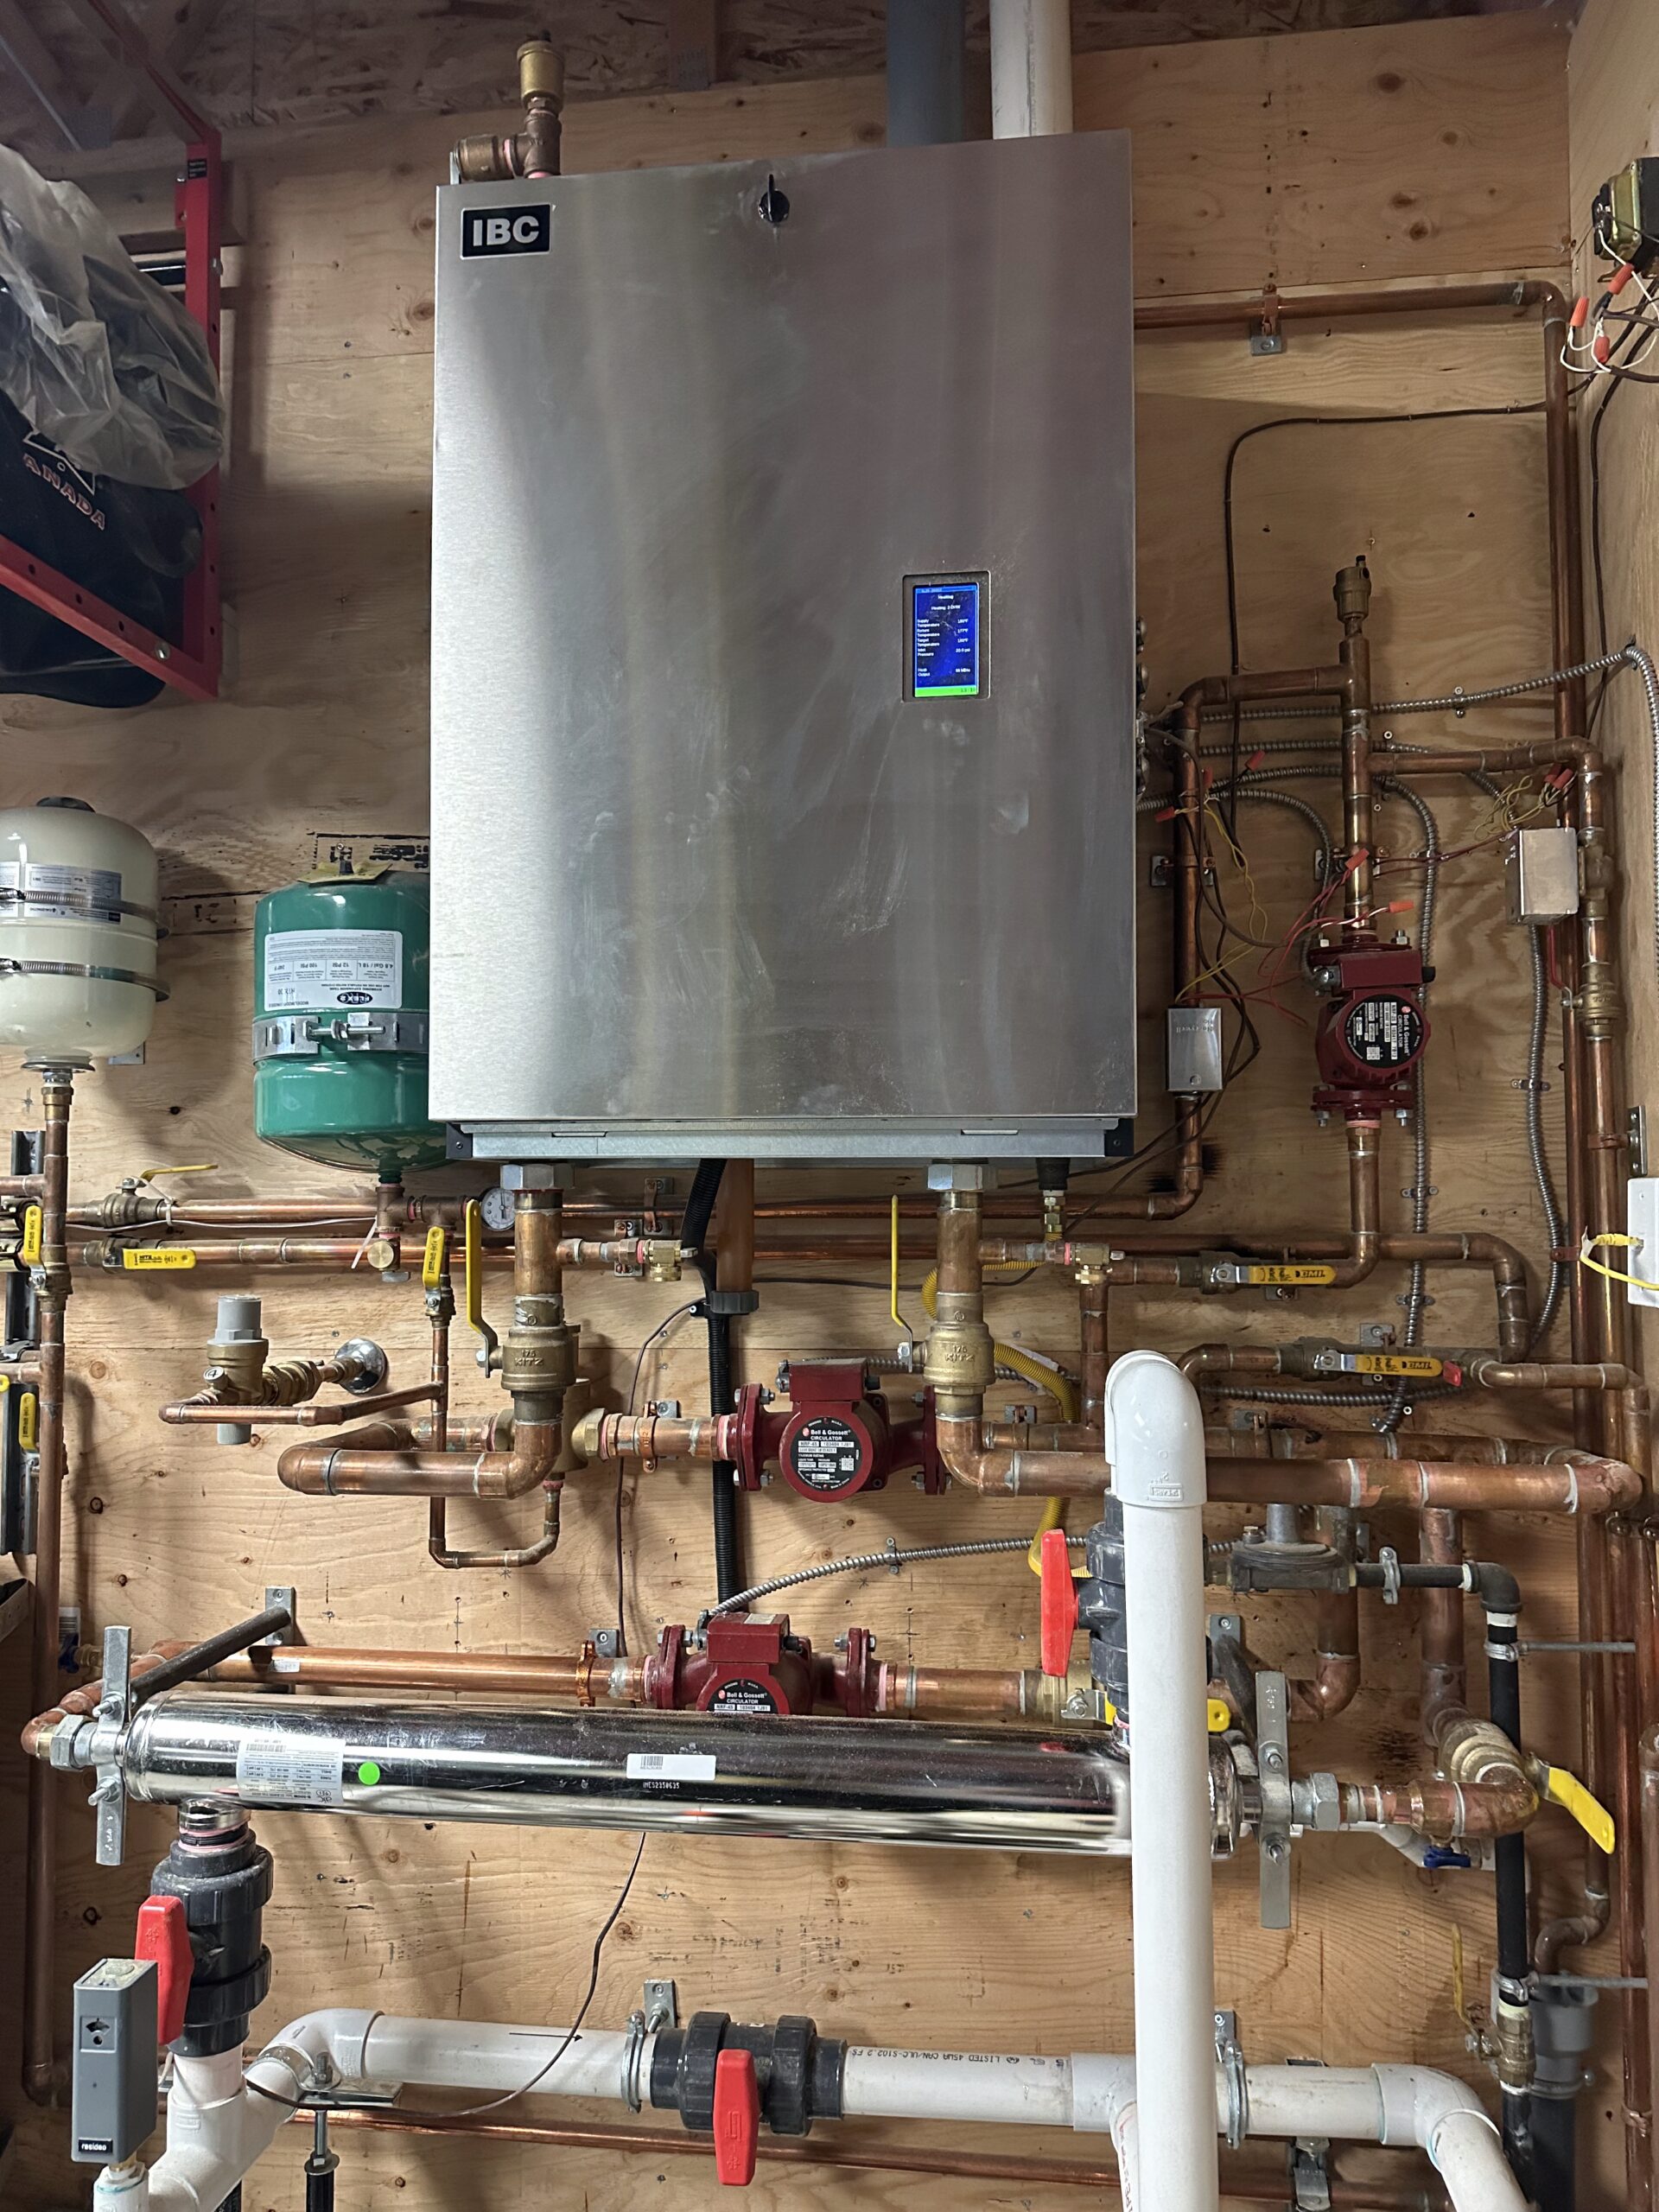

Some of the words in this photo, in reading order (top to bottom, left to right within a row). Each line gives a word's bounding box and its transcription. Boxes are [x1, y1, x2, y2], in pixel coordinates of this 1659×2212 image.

[473, 215, 539, 247] IBC
[515, 1358, 544, 1366] KITZ
[968, 2055, 1000, 2063] LISTED
